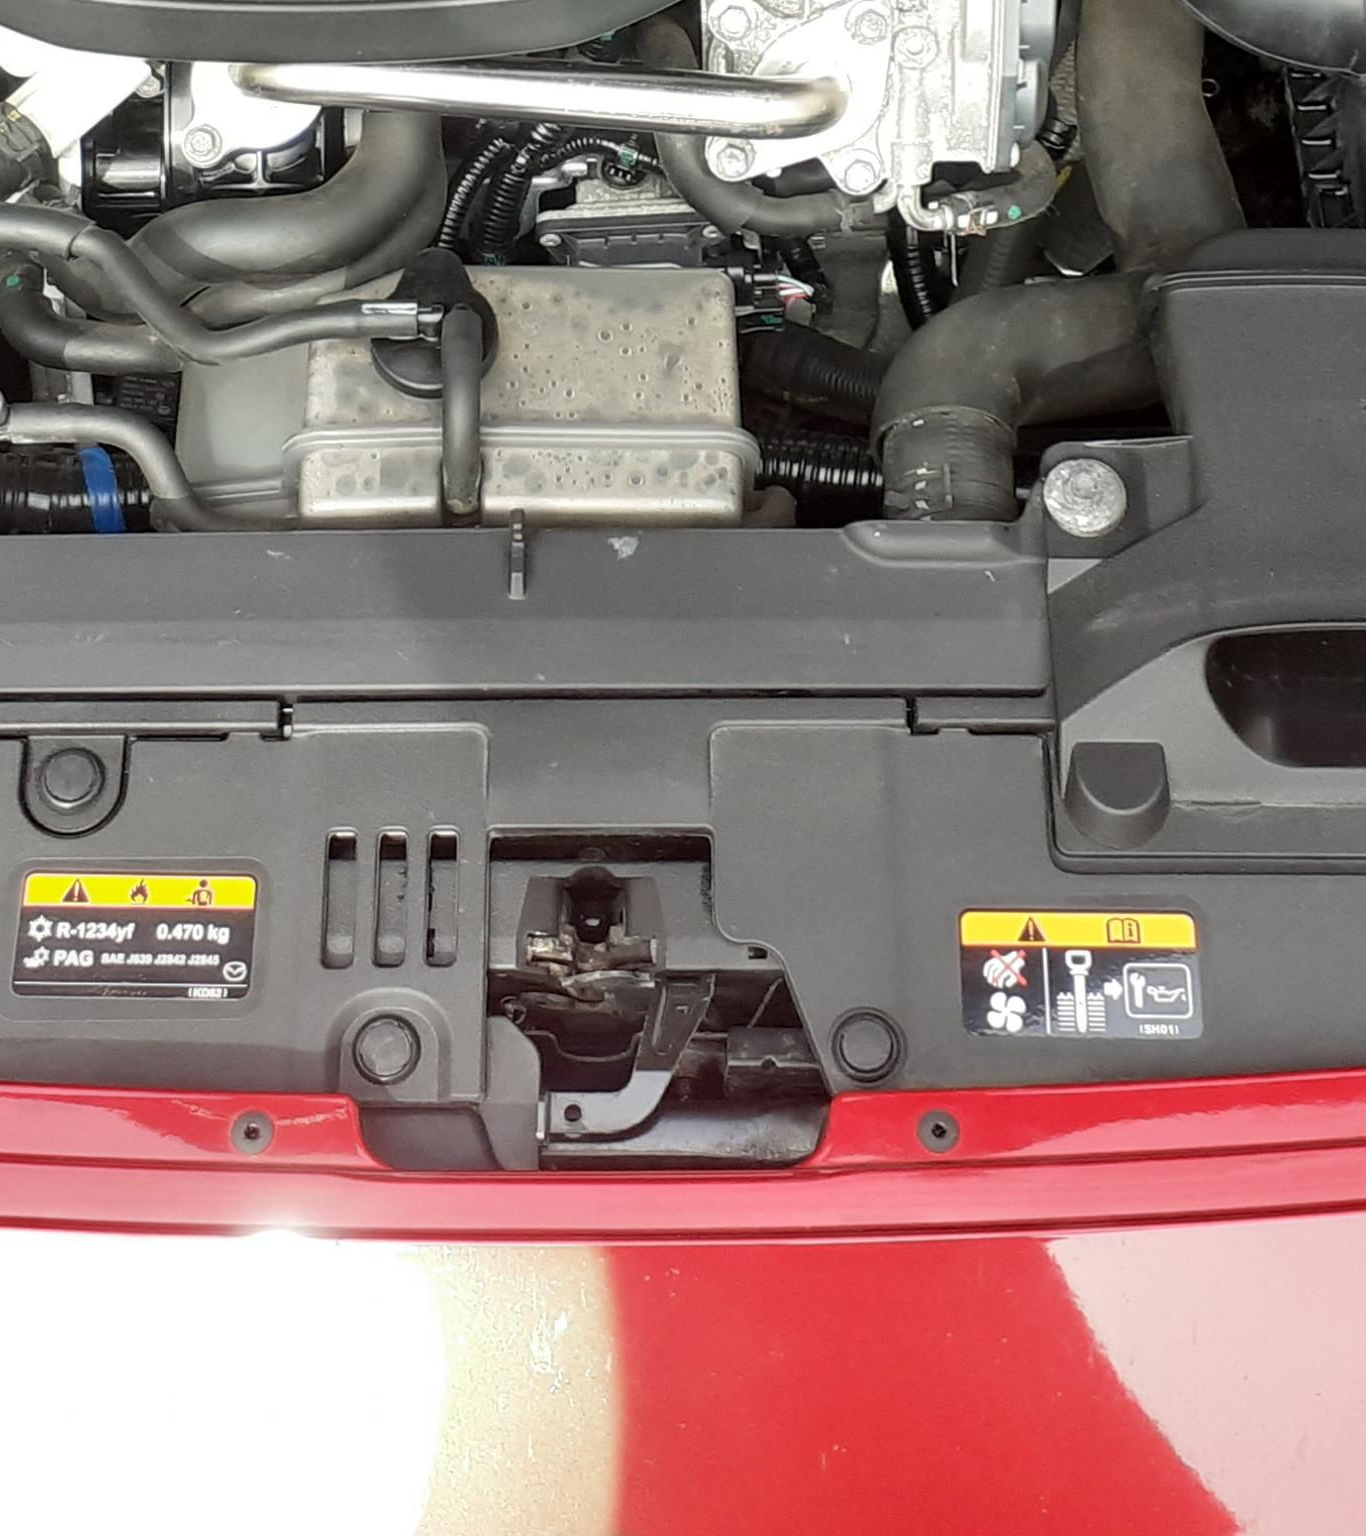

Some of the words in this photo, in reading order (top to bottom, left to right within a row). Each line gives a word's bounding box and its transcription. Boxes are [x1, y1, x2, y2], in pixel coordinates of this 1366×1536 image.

[56, 922, 135, 943] R-1234yf
[156, 923, 204, 940] 0.470
[207, 923, 230, 944] kg
[53, 950, 94, 966] PAG
[100, 953, 124, 965] SAE
